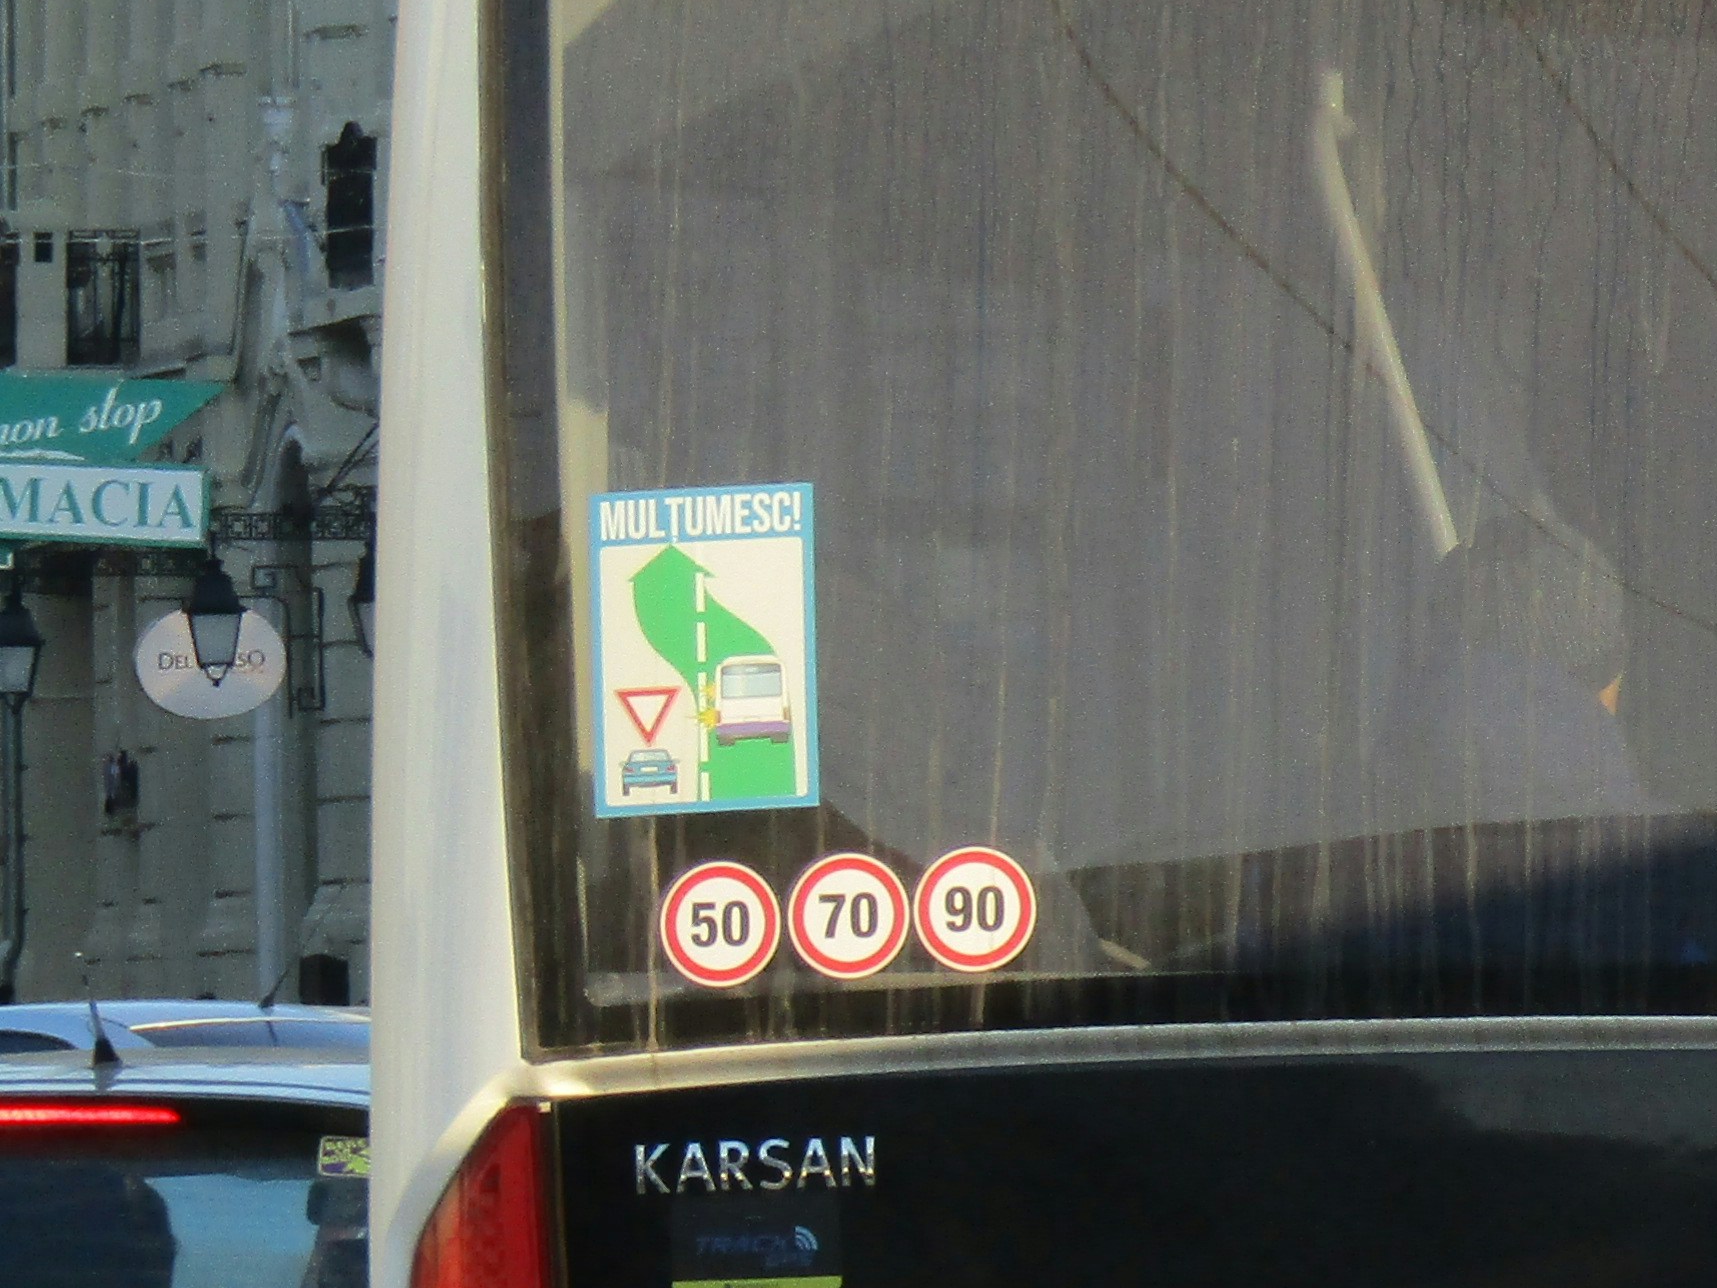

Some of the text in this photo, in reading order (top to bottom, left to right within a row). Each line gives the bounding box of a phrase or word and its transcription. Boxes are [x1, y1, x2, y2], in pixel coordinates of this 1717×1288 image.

[79, 379, 163, 445] stop
[0, 476, 197, 529] MACIA
[690, 900, 751, 948] 50
[817, 892, 879, 939] 70
[943, 885, 1005, 932] 90
[634, 1135, 876, 1196] KARSAN
